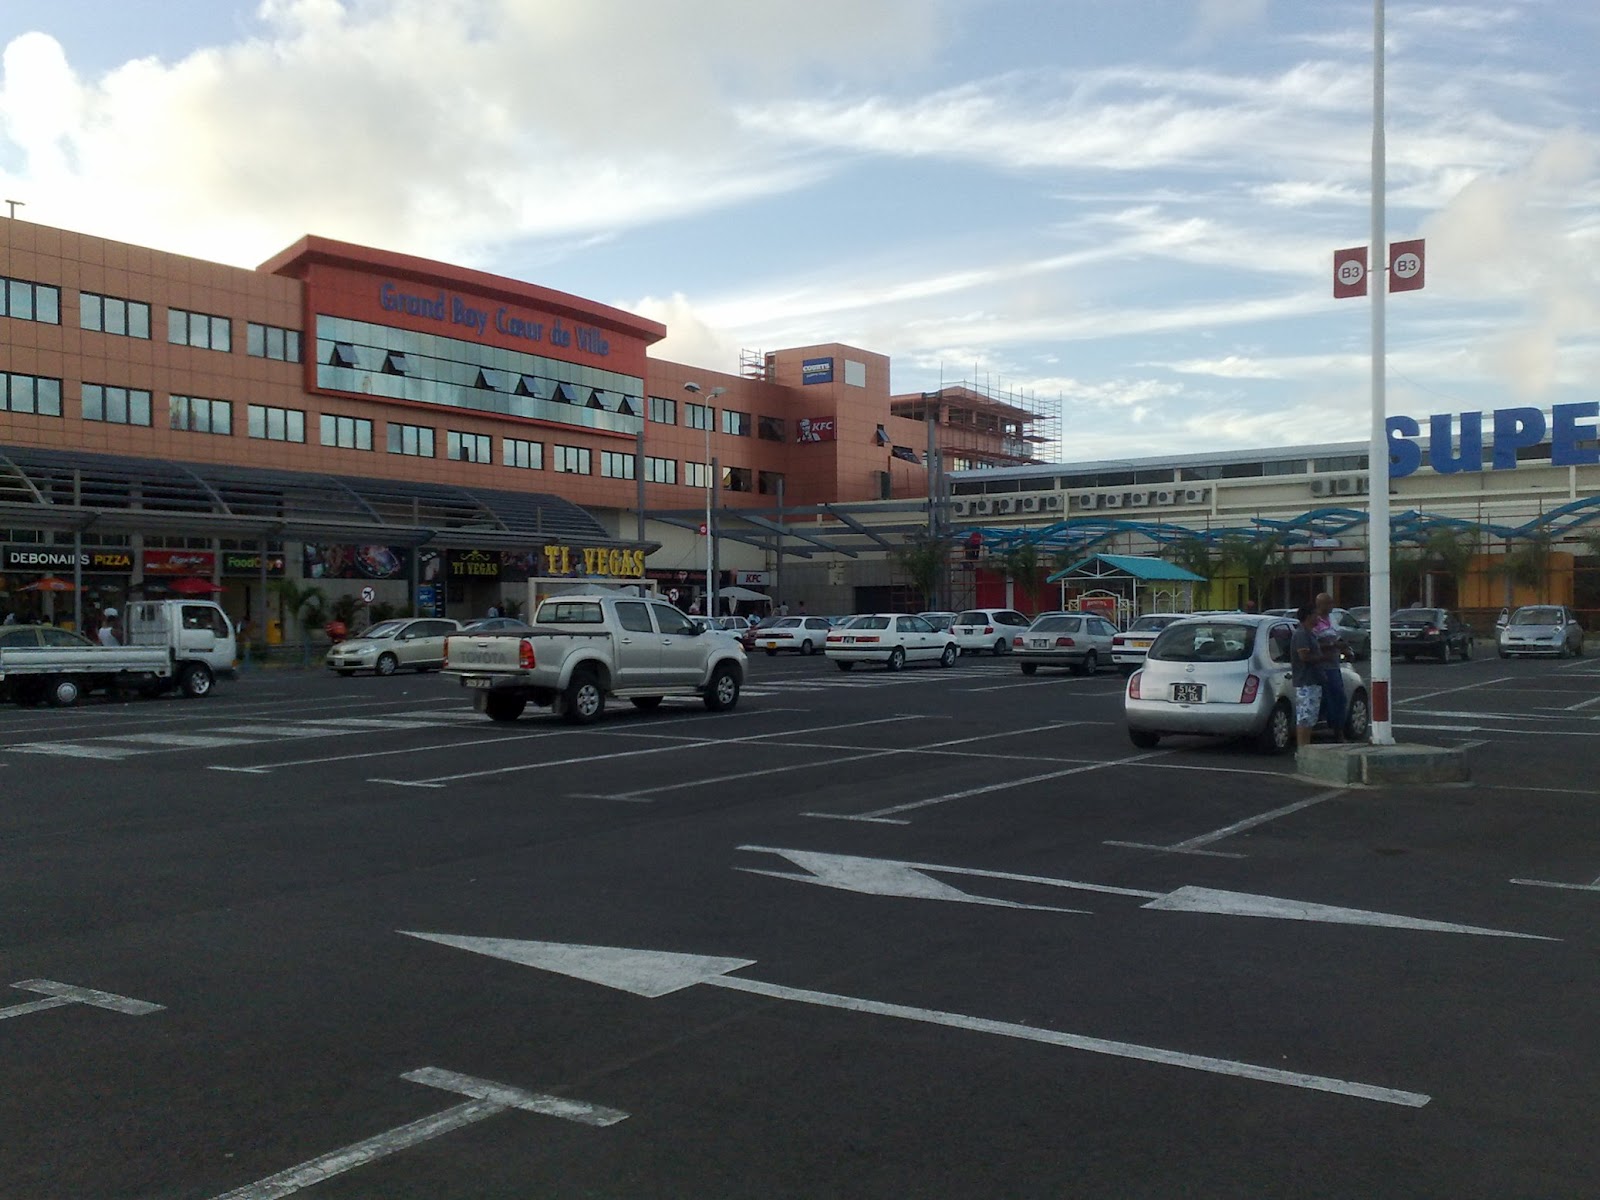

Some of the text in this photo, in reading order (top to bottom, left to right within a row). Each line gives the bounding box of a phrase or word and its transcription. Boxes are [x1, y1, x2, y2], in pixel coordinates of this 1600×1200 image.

[1397, 259, 1417, 272] B3
[1341, 266, 1360, 279] B3
[380, 282, 445, 321] Grand
[550, 319, 571, 348] de
[575, 326, 609, 356] Ville
[812, 421, 833, 432] KFC
[94, 554, 131, 566] PIZZA
[544, 544, 645, 577] TI VEGAS
[452, 561, 498, 576] TI VEGAS
[745, 574, 762, 583] KFC
[460, 651, 507, 664] TOYOTA
